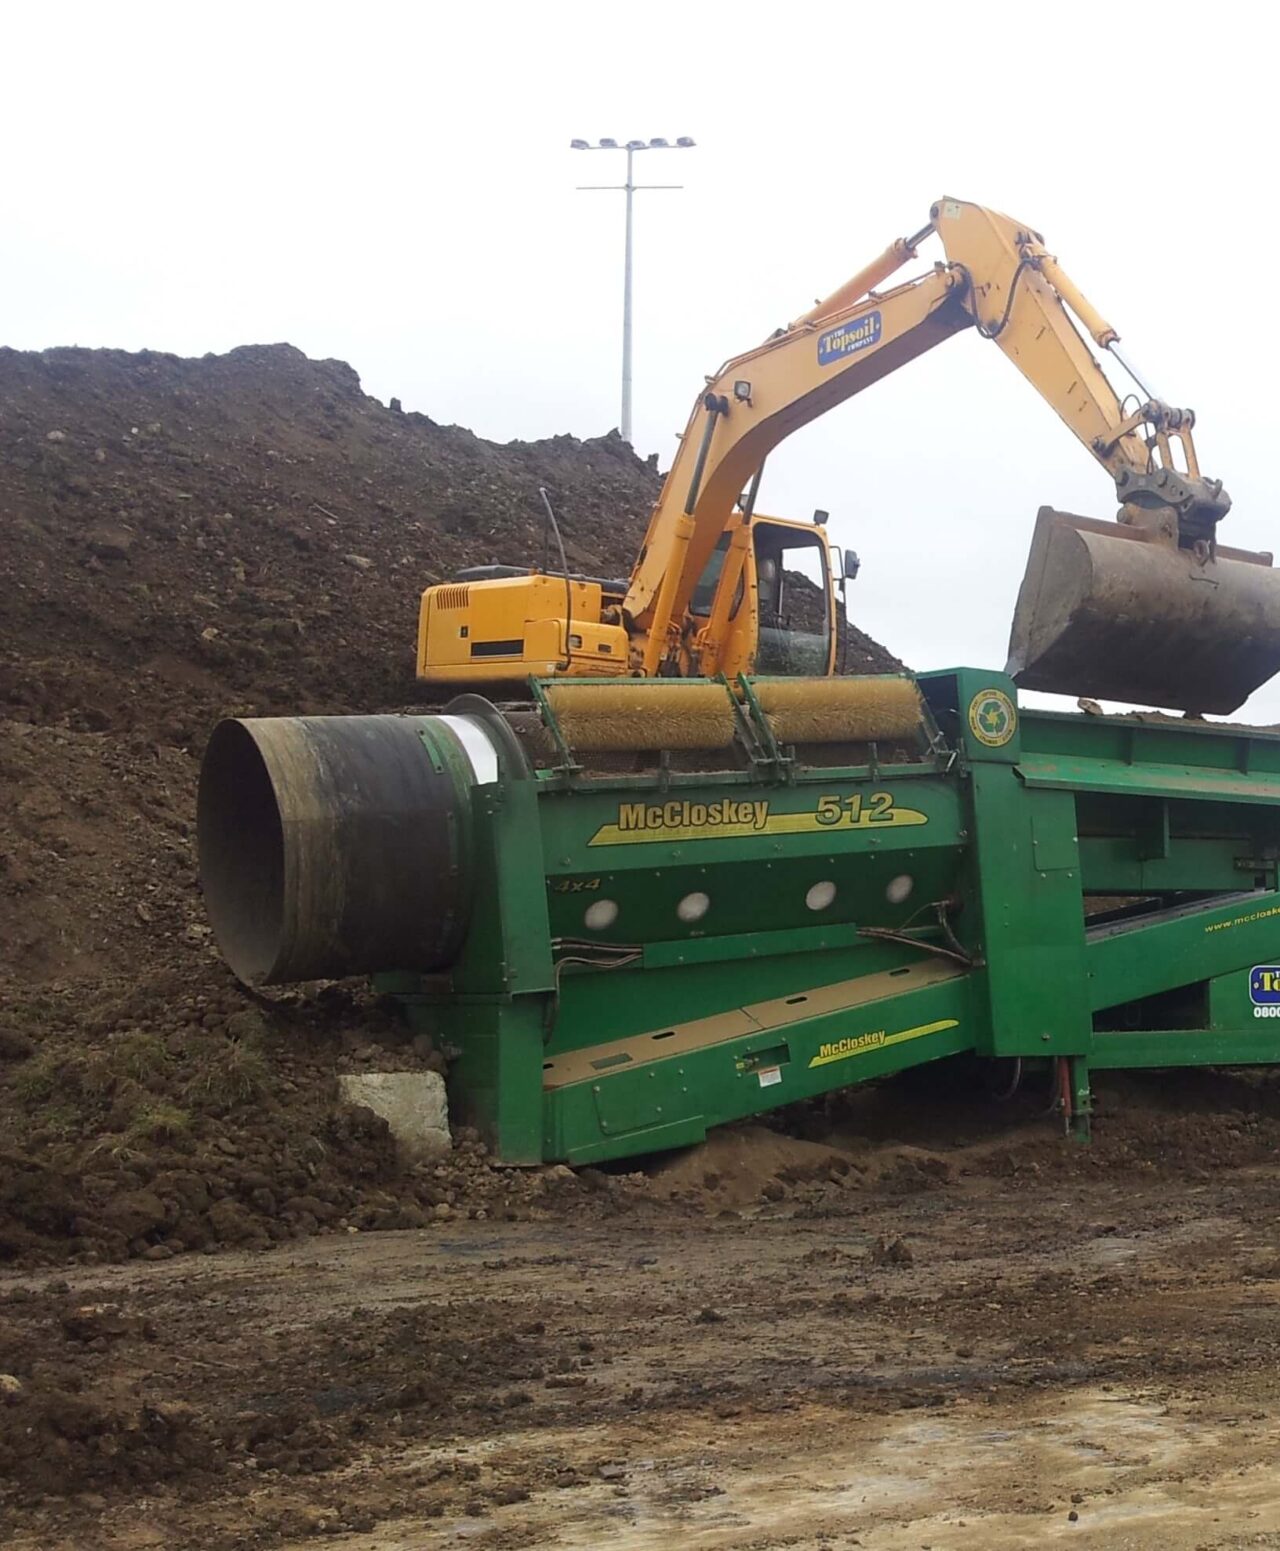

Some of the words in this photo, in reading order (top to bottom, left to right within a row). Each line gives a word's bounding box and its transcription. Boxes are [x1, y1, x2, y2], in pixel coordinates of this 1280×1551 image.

[823, 317, 875, 354] Topsoil
[618, 798, 768, 831] McCloskey
[815, 792, 894, 825] 512
[819, 1029, 886, 1059] McCloskey
